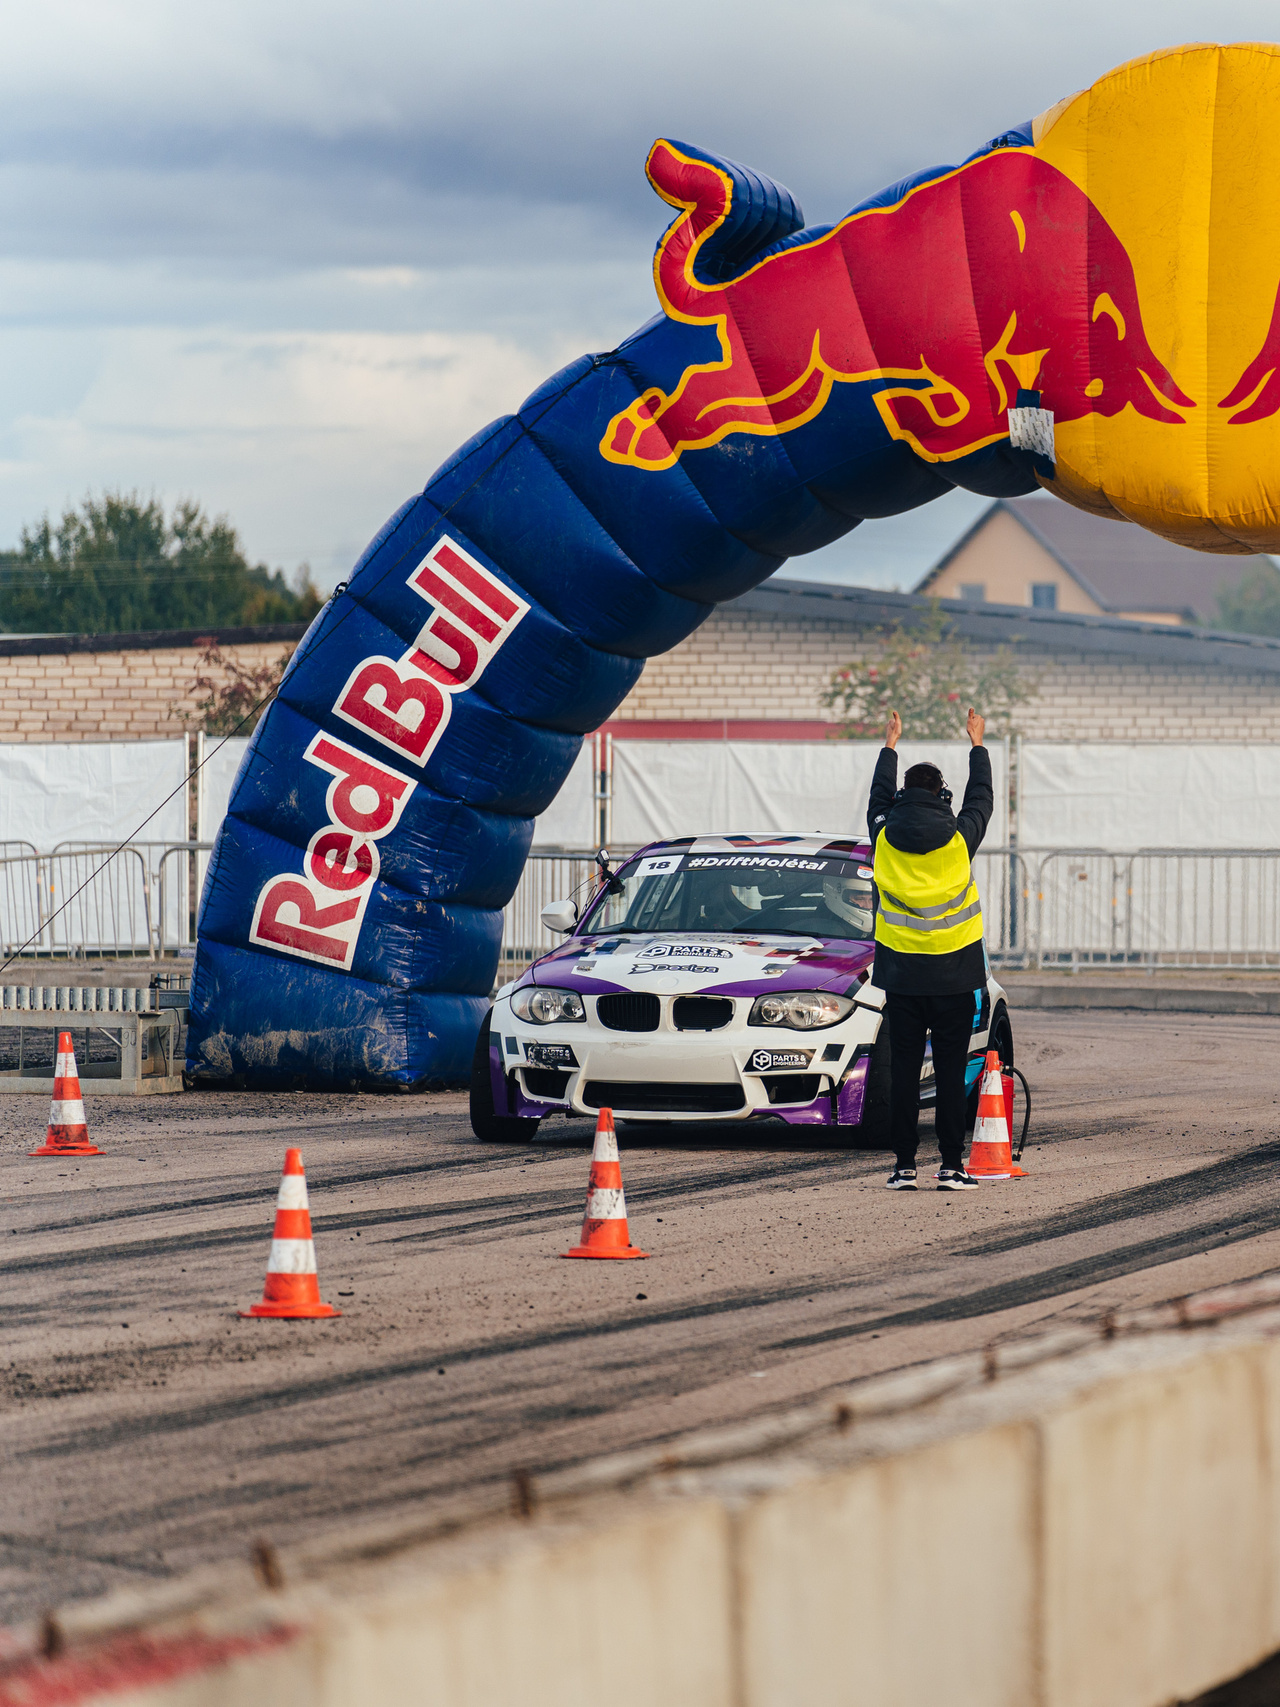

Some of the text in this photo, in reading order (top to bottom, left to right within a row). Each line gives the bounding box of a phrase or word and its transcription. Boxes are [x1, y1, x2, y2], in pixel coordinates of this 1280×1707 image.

[251, 537, 527, 968] Red Bull
[648, 861, 672, 871] 18
[672, 946, 719, 954] PARTS
[772, 1054, 806, 1062] PARTS &
